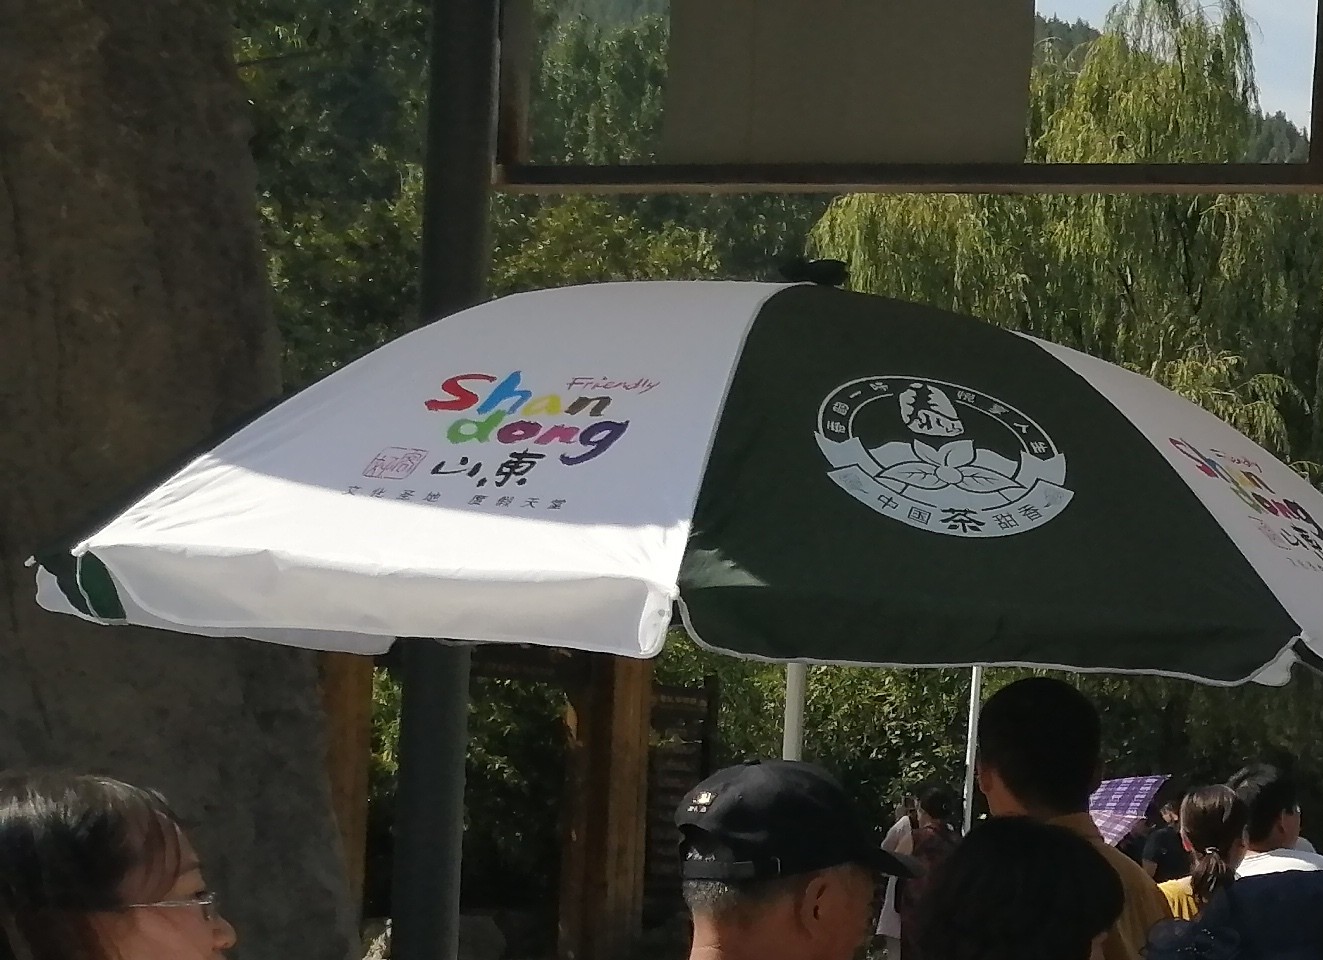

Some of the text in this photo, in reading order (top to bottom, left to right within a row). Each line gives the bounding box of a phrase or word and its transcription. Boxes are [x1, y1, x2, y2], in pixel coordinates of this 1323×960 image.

[424, 370, 612, 417] Shan
[565, 376, 660, 394] Friendly
[446, 409, 630, 466] dong
[877, 493, 1043, 534] 中国茶甜香
